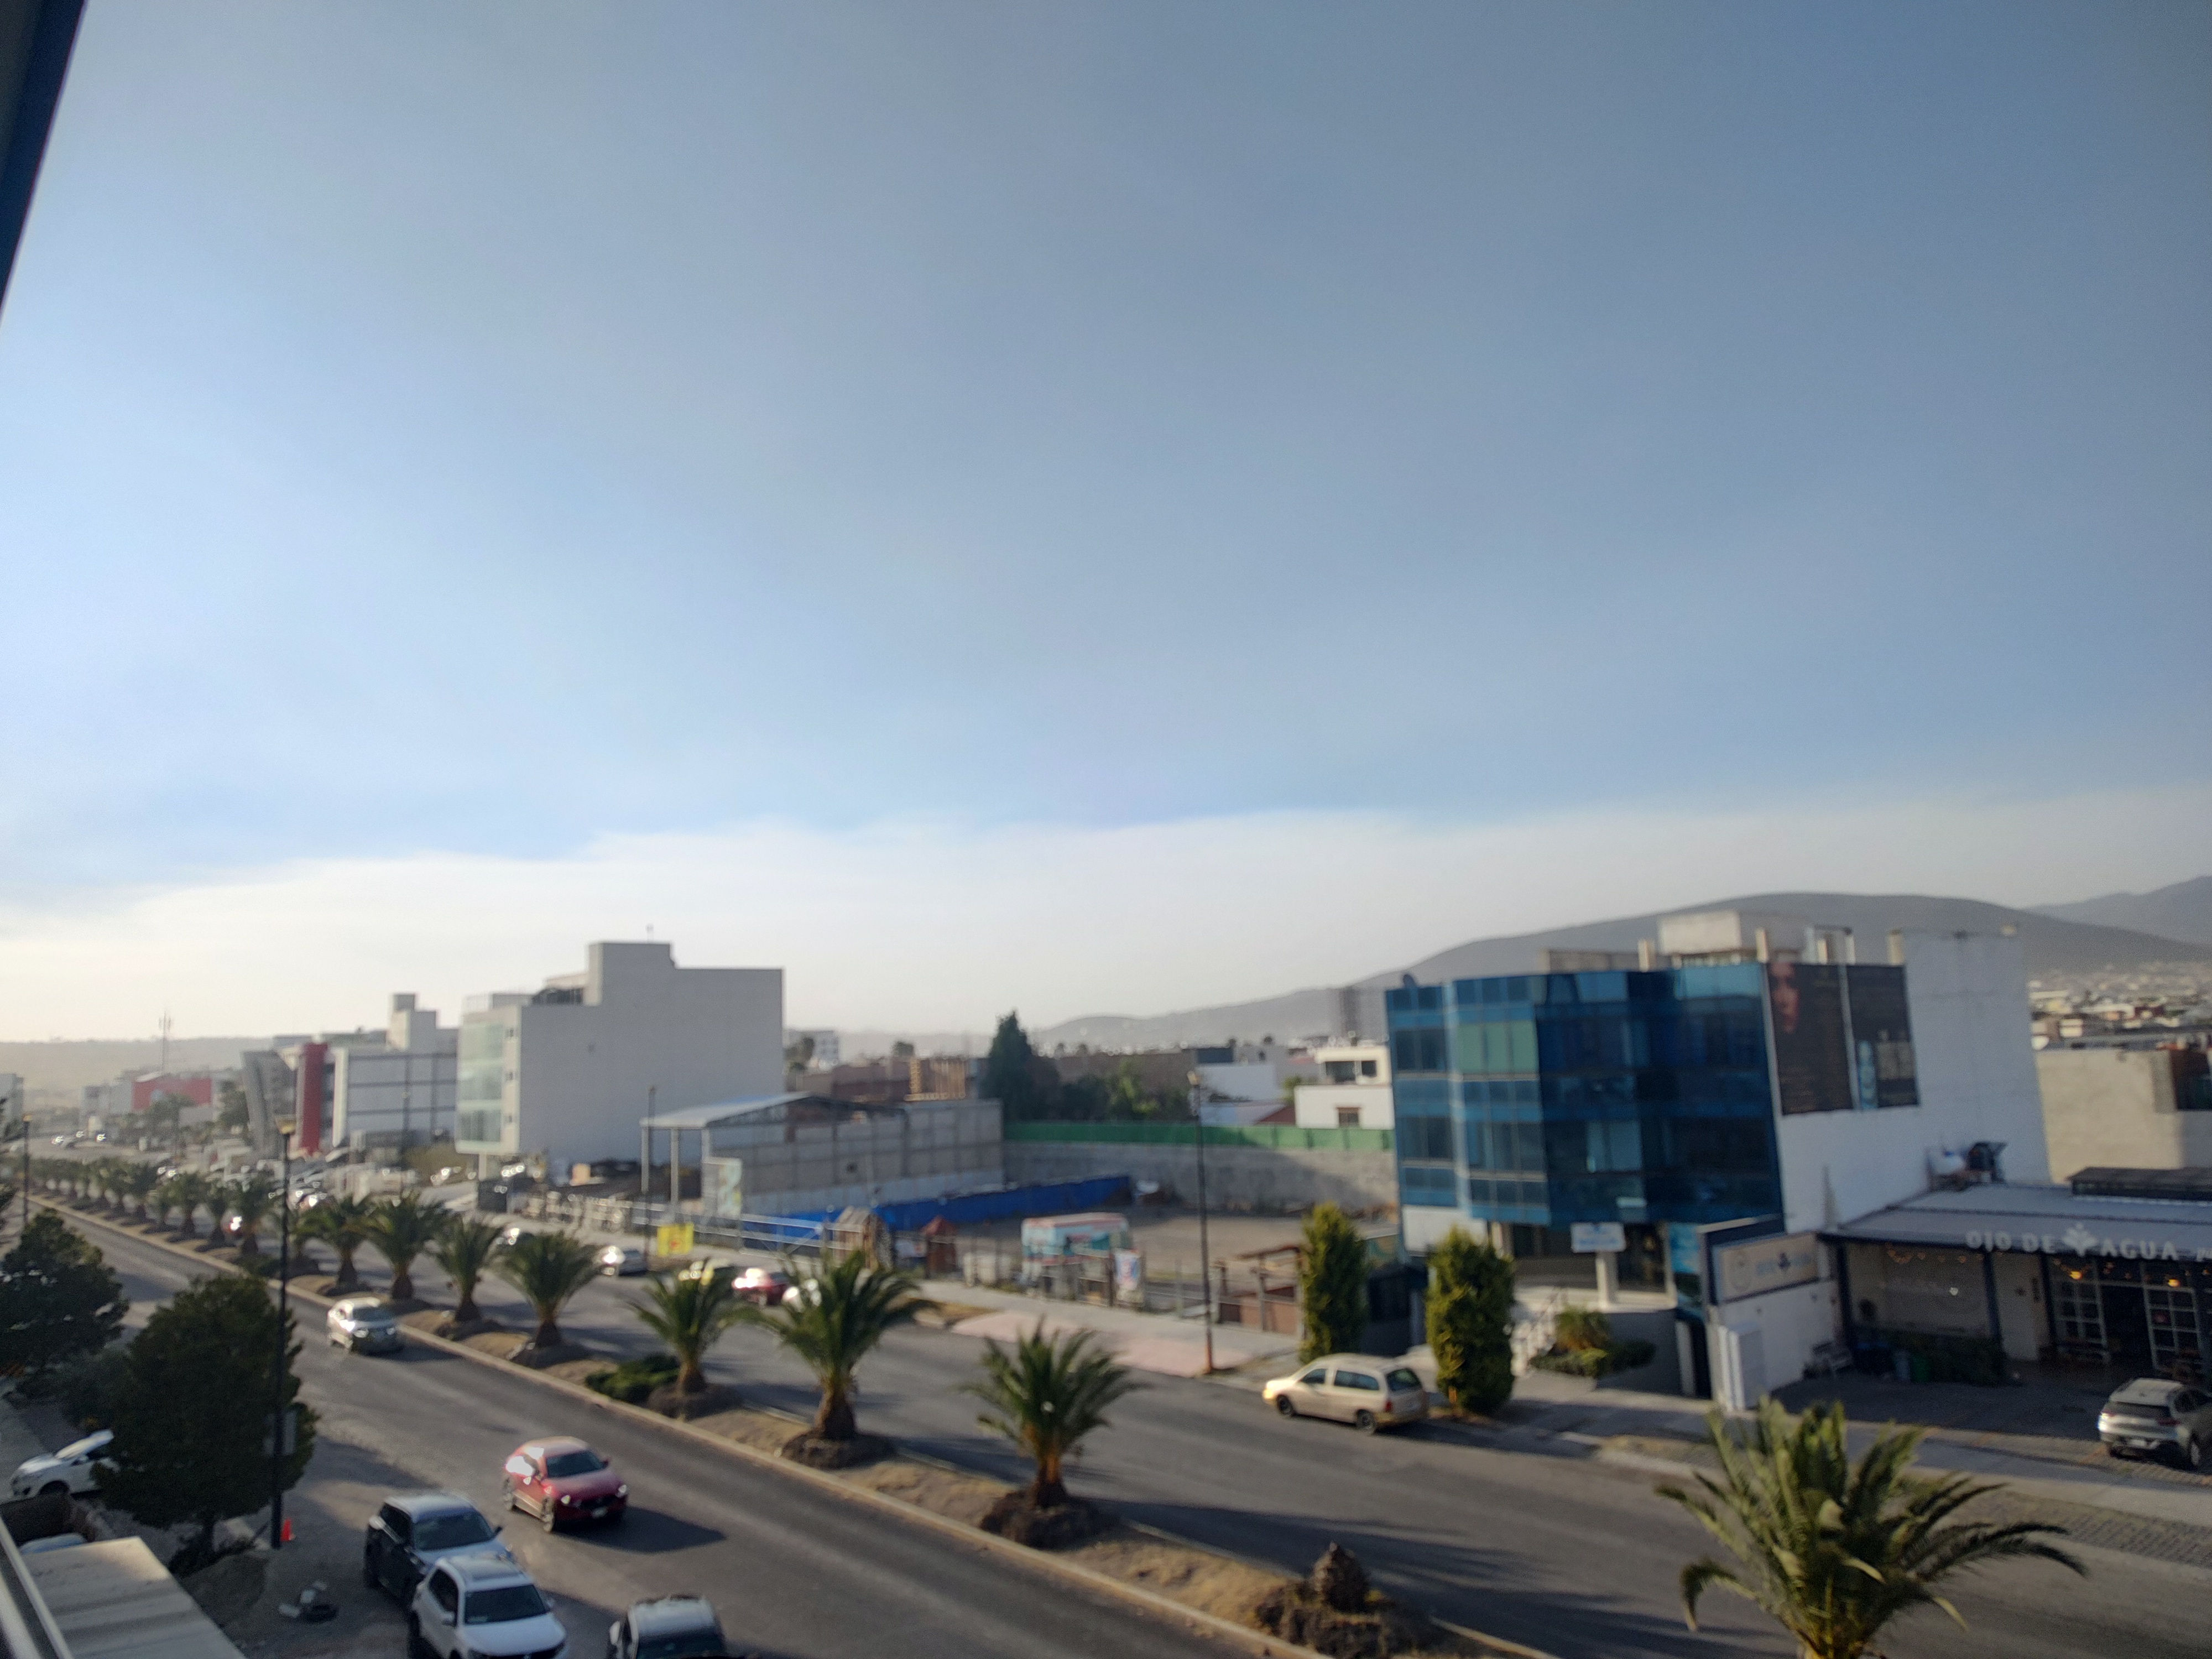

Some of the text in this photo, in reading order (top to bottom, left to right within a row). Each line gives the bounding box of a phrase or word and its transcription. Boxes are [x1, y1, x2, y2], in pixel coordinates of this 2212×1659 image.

[1966, 1230, 2012, 1251] OJO
[2021, 1232, 2057, 1254] DE
[2100, 1238, 2179, 1261] AGUA
